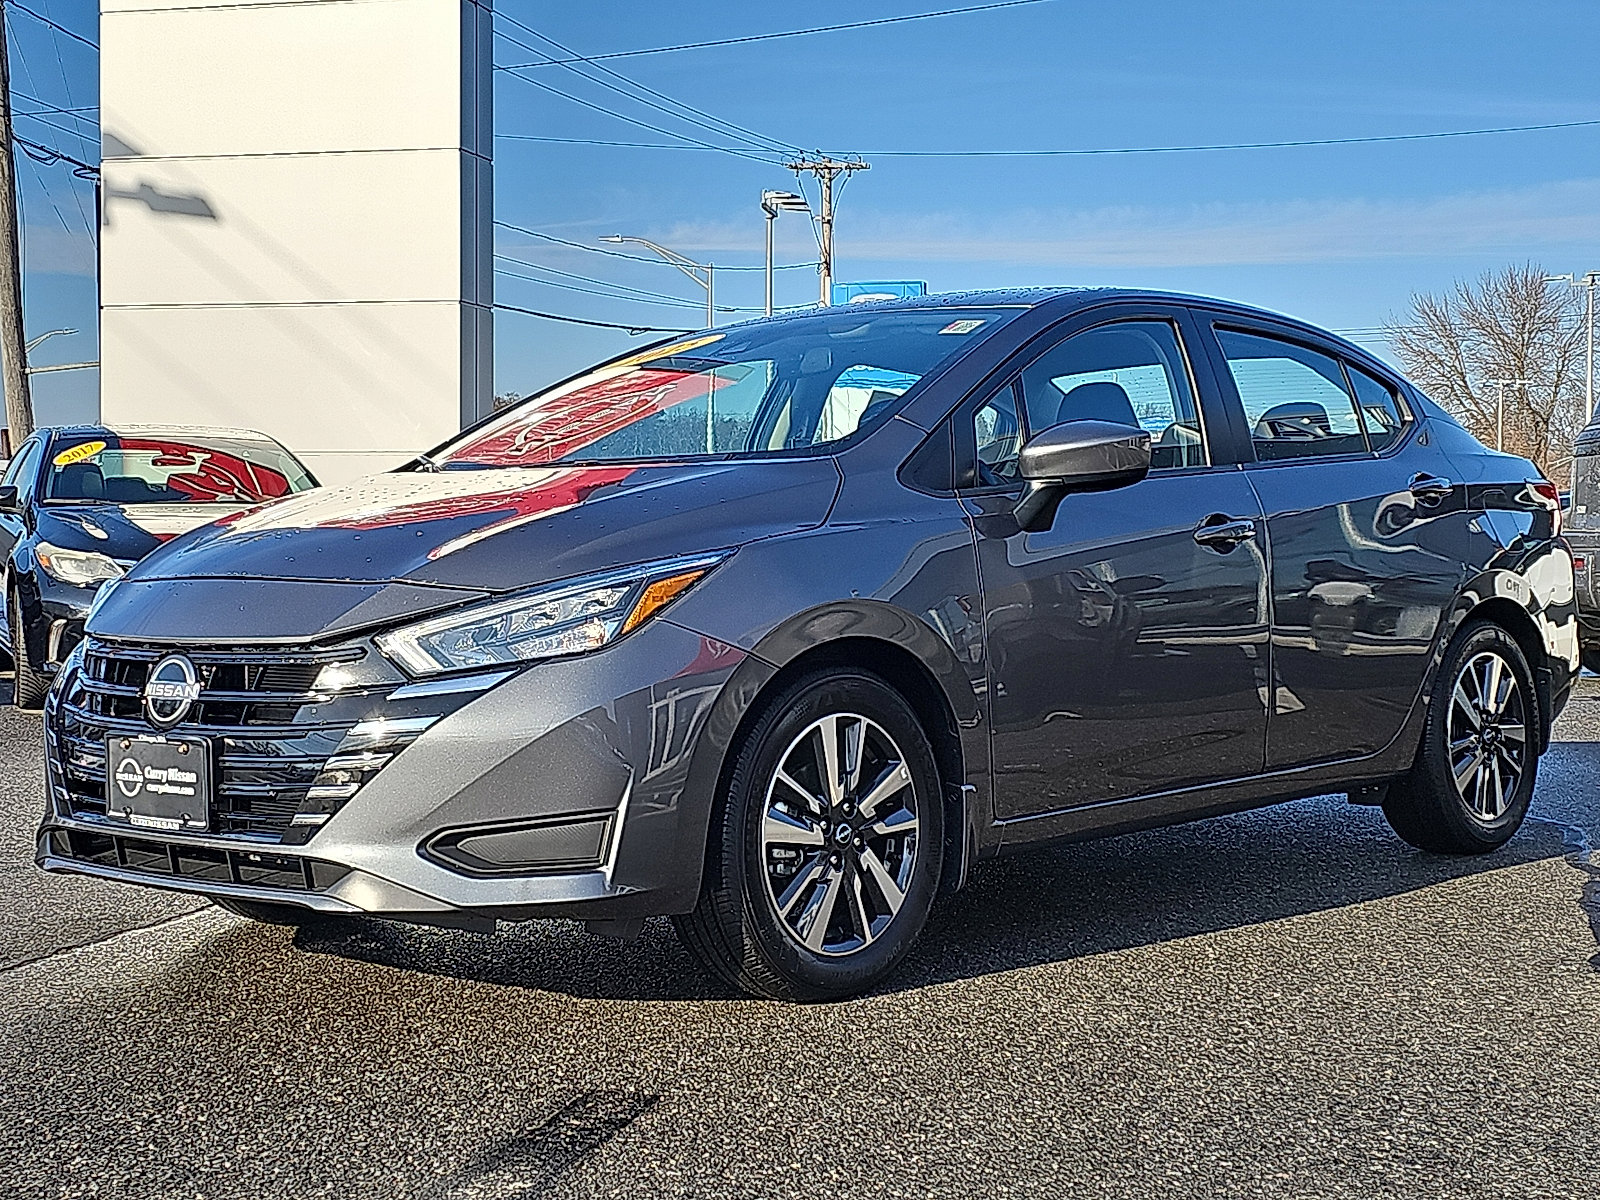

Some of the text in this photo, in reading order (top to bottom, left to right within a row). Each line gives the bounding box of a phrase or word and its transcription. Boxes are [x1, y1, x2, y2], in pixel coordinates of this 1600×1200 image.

[63, 444, 94, 462] 2017
[144, 683, 199, 699] NISSAN
[144, 765, 197, 783] Curry Nissan
